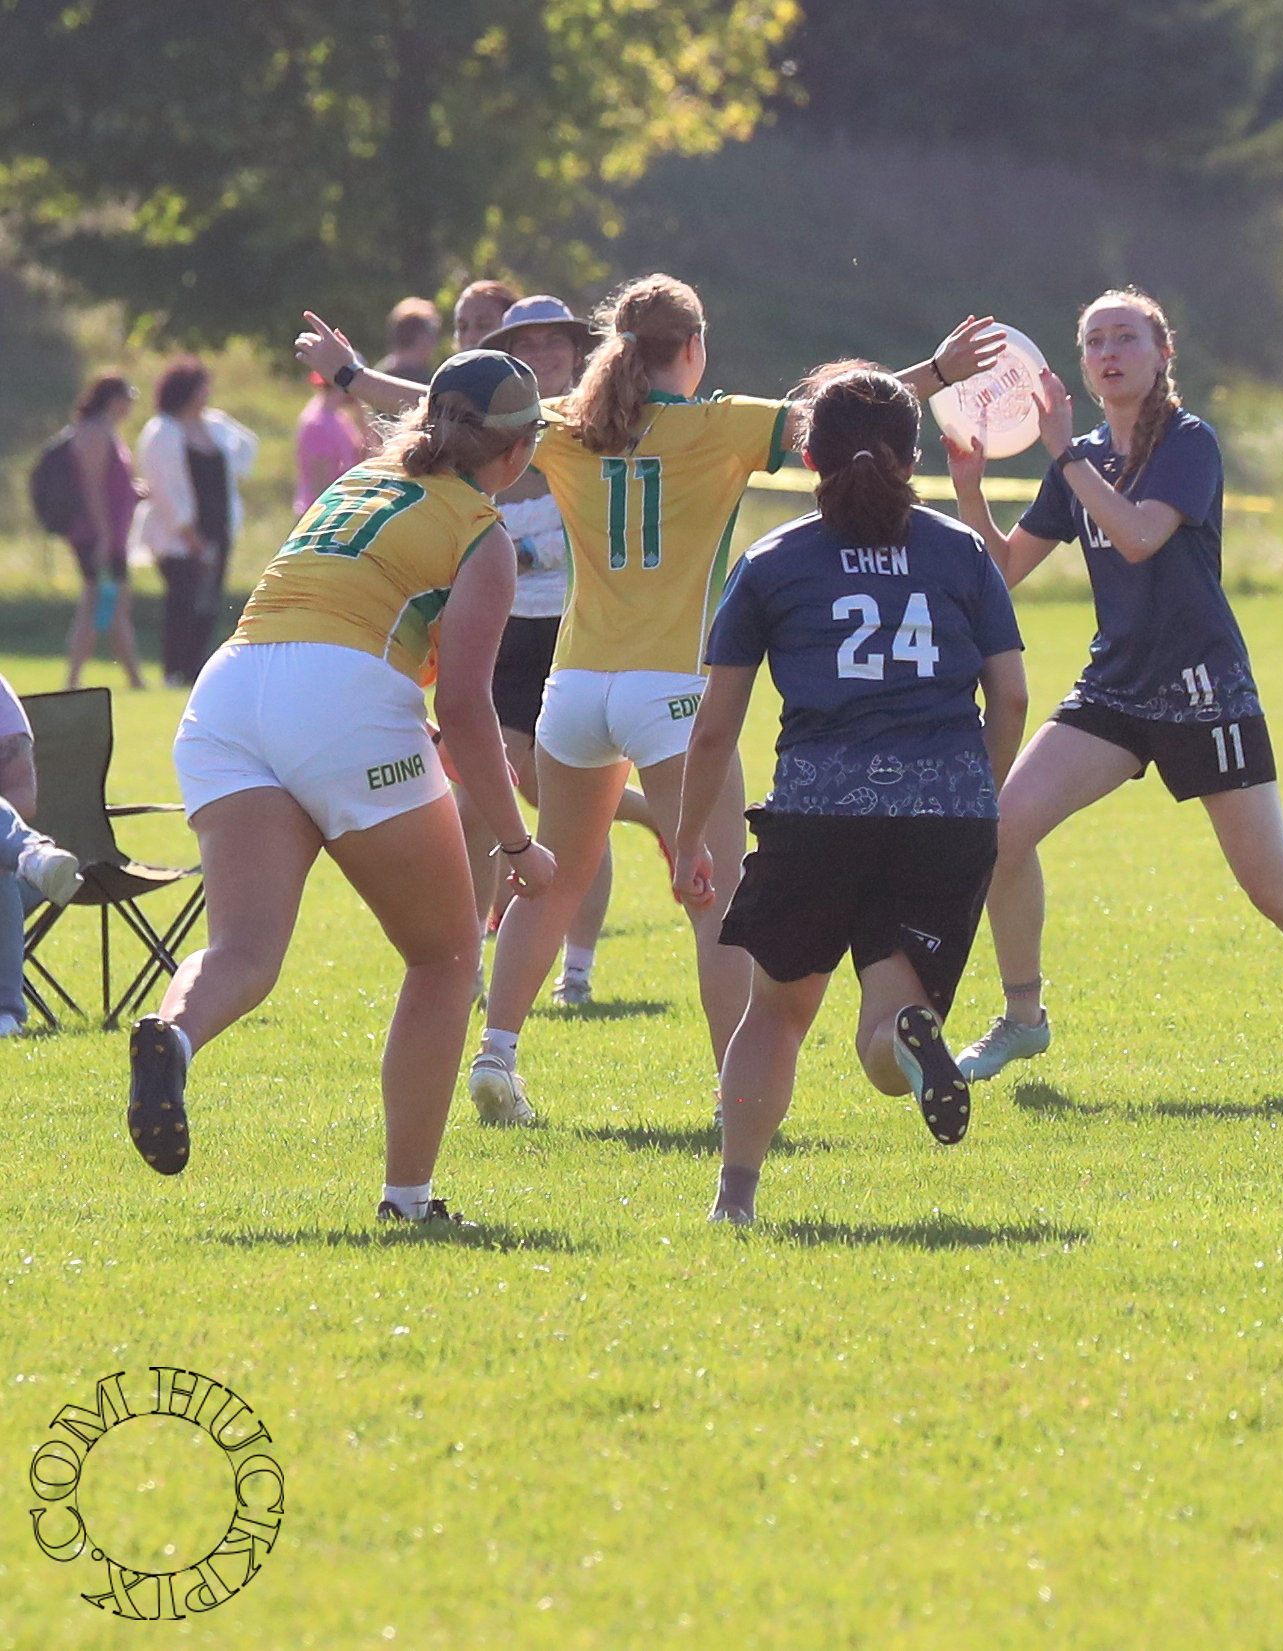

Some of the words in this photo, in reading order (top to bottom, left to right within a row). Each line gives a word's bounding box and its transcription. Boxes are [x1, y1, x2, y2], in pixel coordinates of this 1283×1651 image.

[600, 456, 662, 570] 11
[840, 546, 909, 576] CHEN
[832, 592, 940, 681] 24
[1182, 663, 1213, 707] 11
[1211, 722, 1246, 773] 11
[366, 753, 426, 791] EDINA
